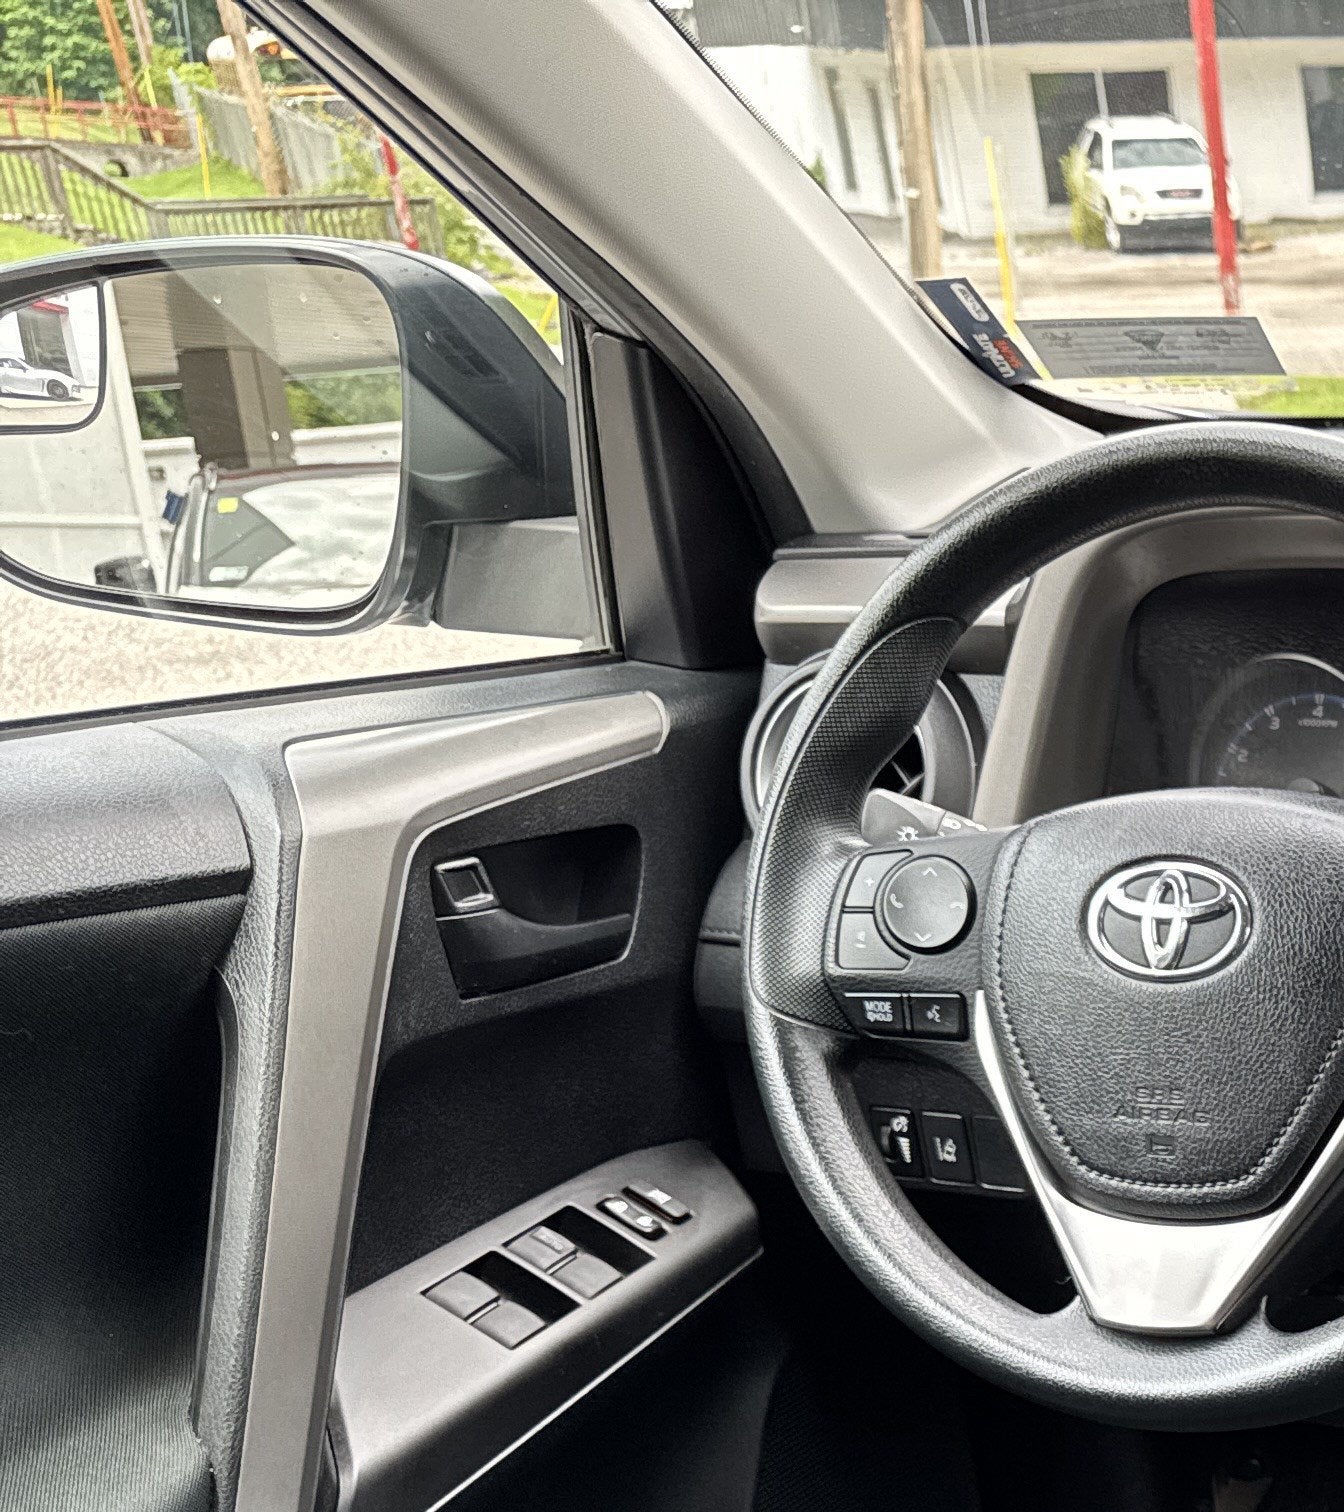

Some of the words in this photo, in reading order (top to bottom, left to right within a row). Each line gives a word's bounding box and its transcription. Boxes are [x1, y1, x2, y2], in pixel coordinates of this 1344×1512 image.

[1312, 705, 1323, 718] 4
[1269, 717, 1280, 730] 3
[1238, 749, 1248, 763] 2
[863, 1000, 893, 1013] MODE
[1112, 1105, 1211, 1126] AIRBAG
